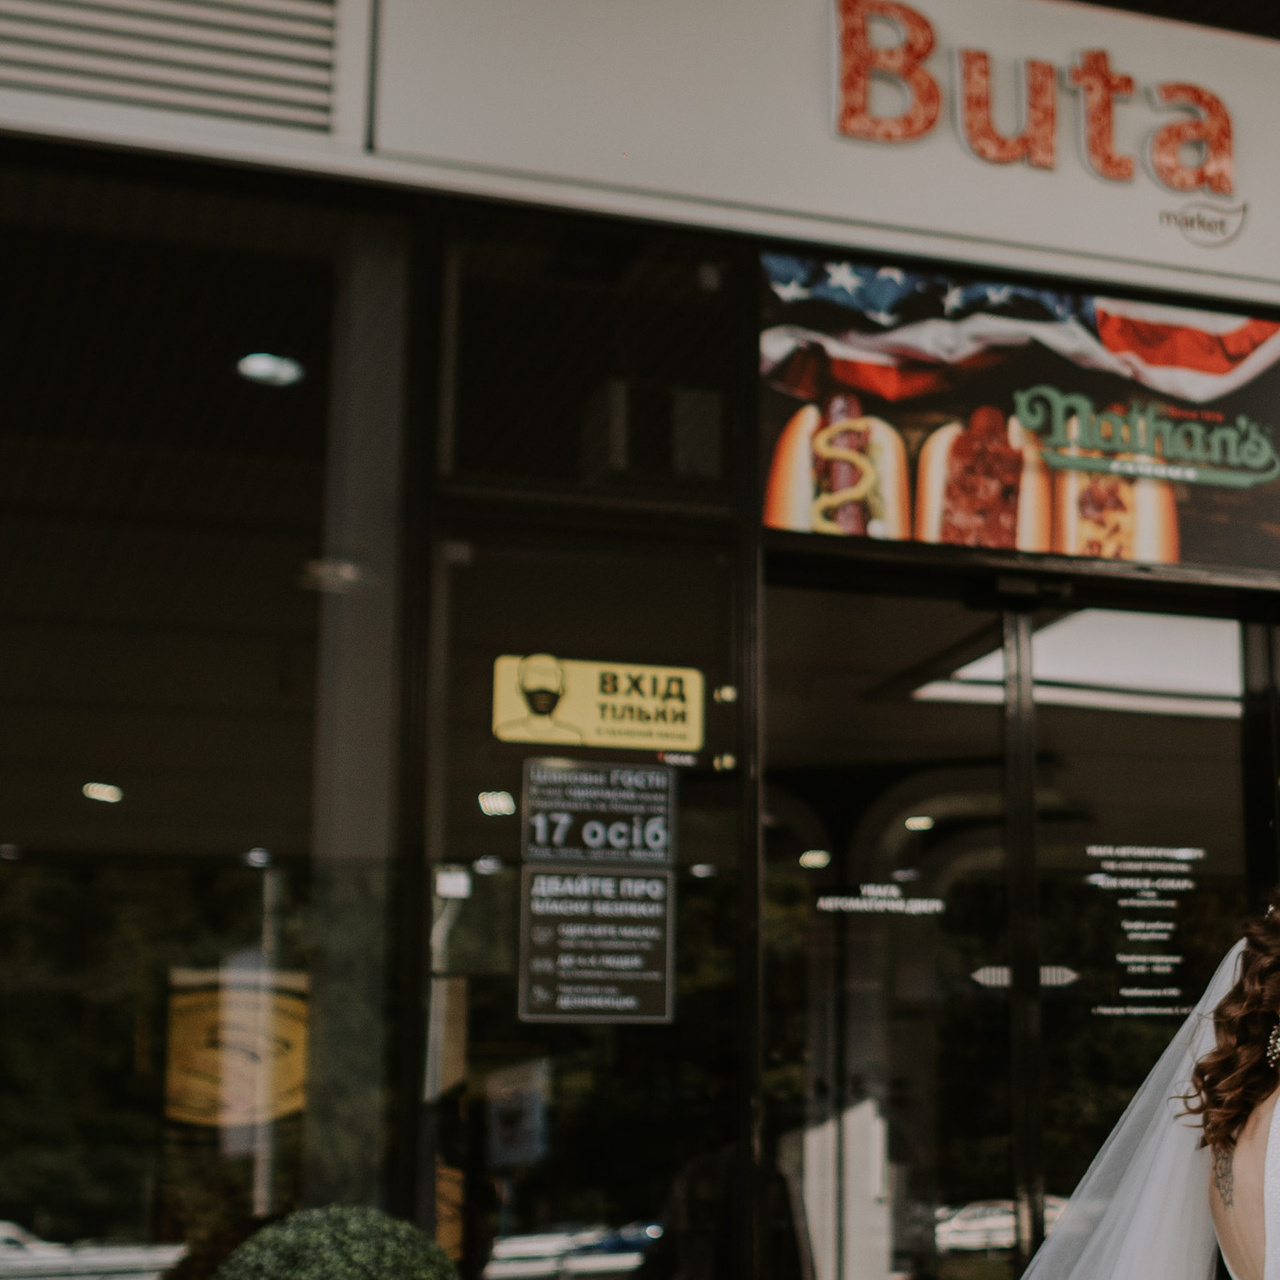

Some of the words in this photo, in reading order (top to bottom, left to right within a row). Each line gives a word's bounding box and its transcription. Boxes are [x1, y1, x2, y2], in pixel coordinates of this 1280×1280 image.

[1158, 211, 1226, 235] market
[600, 672, 686, 704] ВХІД
[599, 702, 687, 725] ТІЛЬКИ
[530, 813, 572, 845] 17
[582, 815, 668, 849] осіб
[619, 878, 665, 900] ПРО
